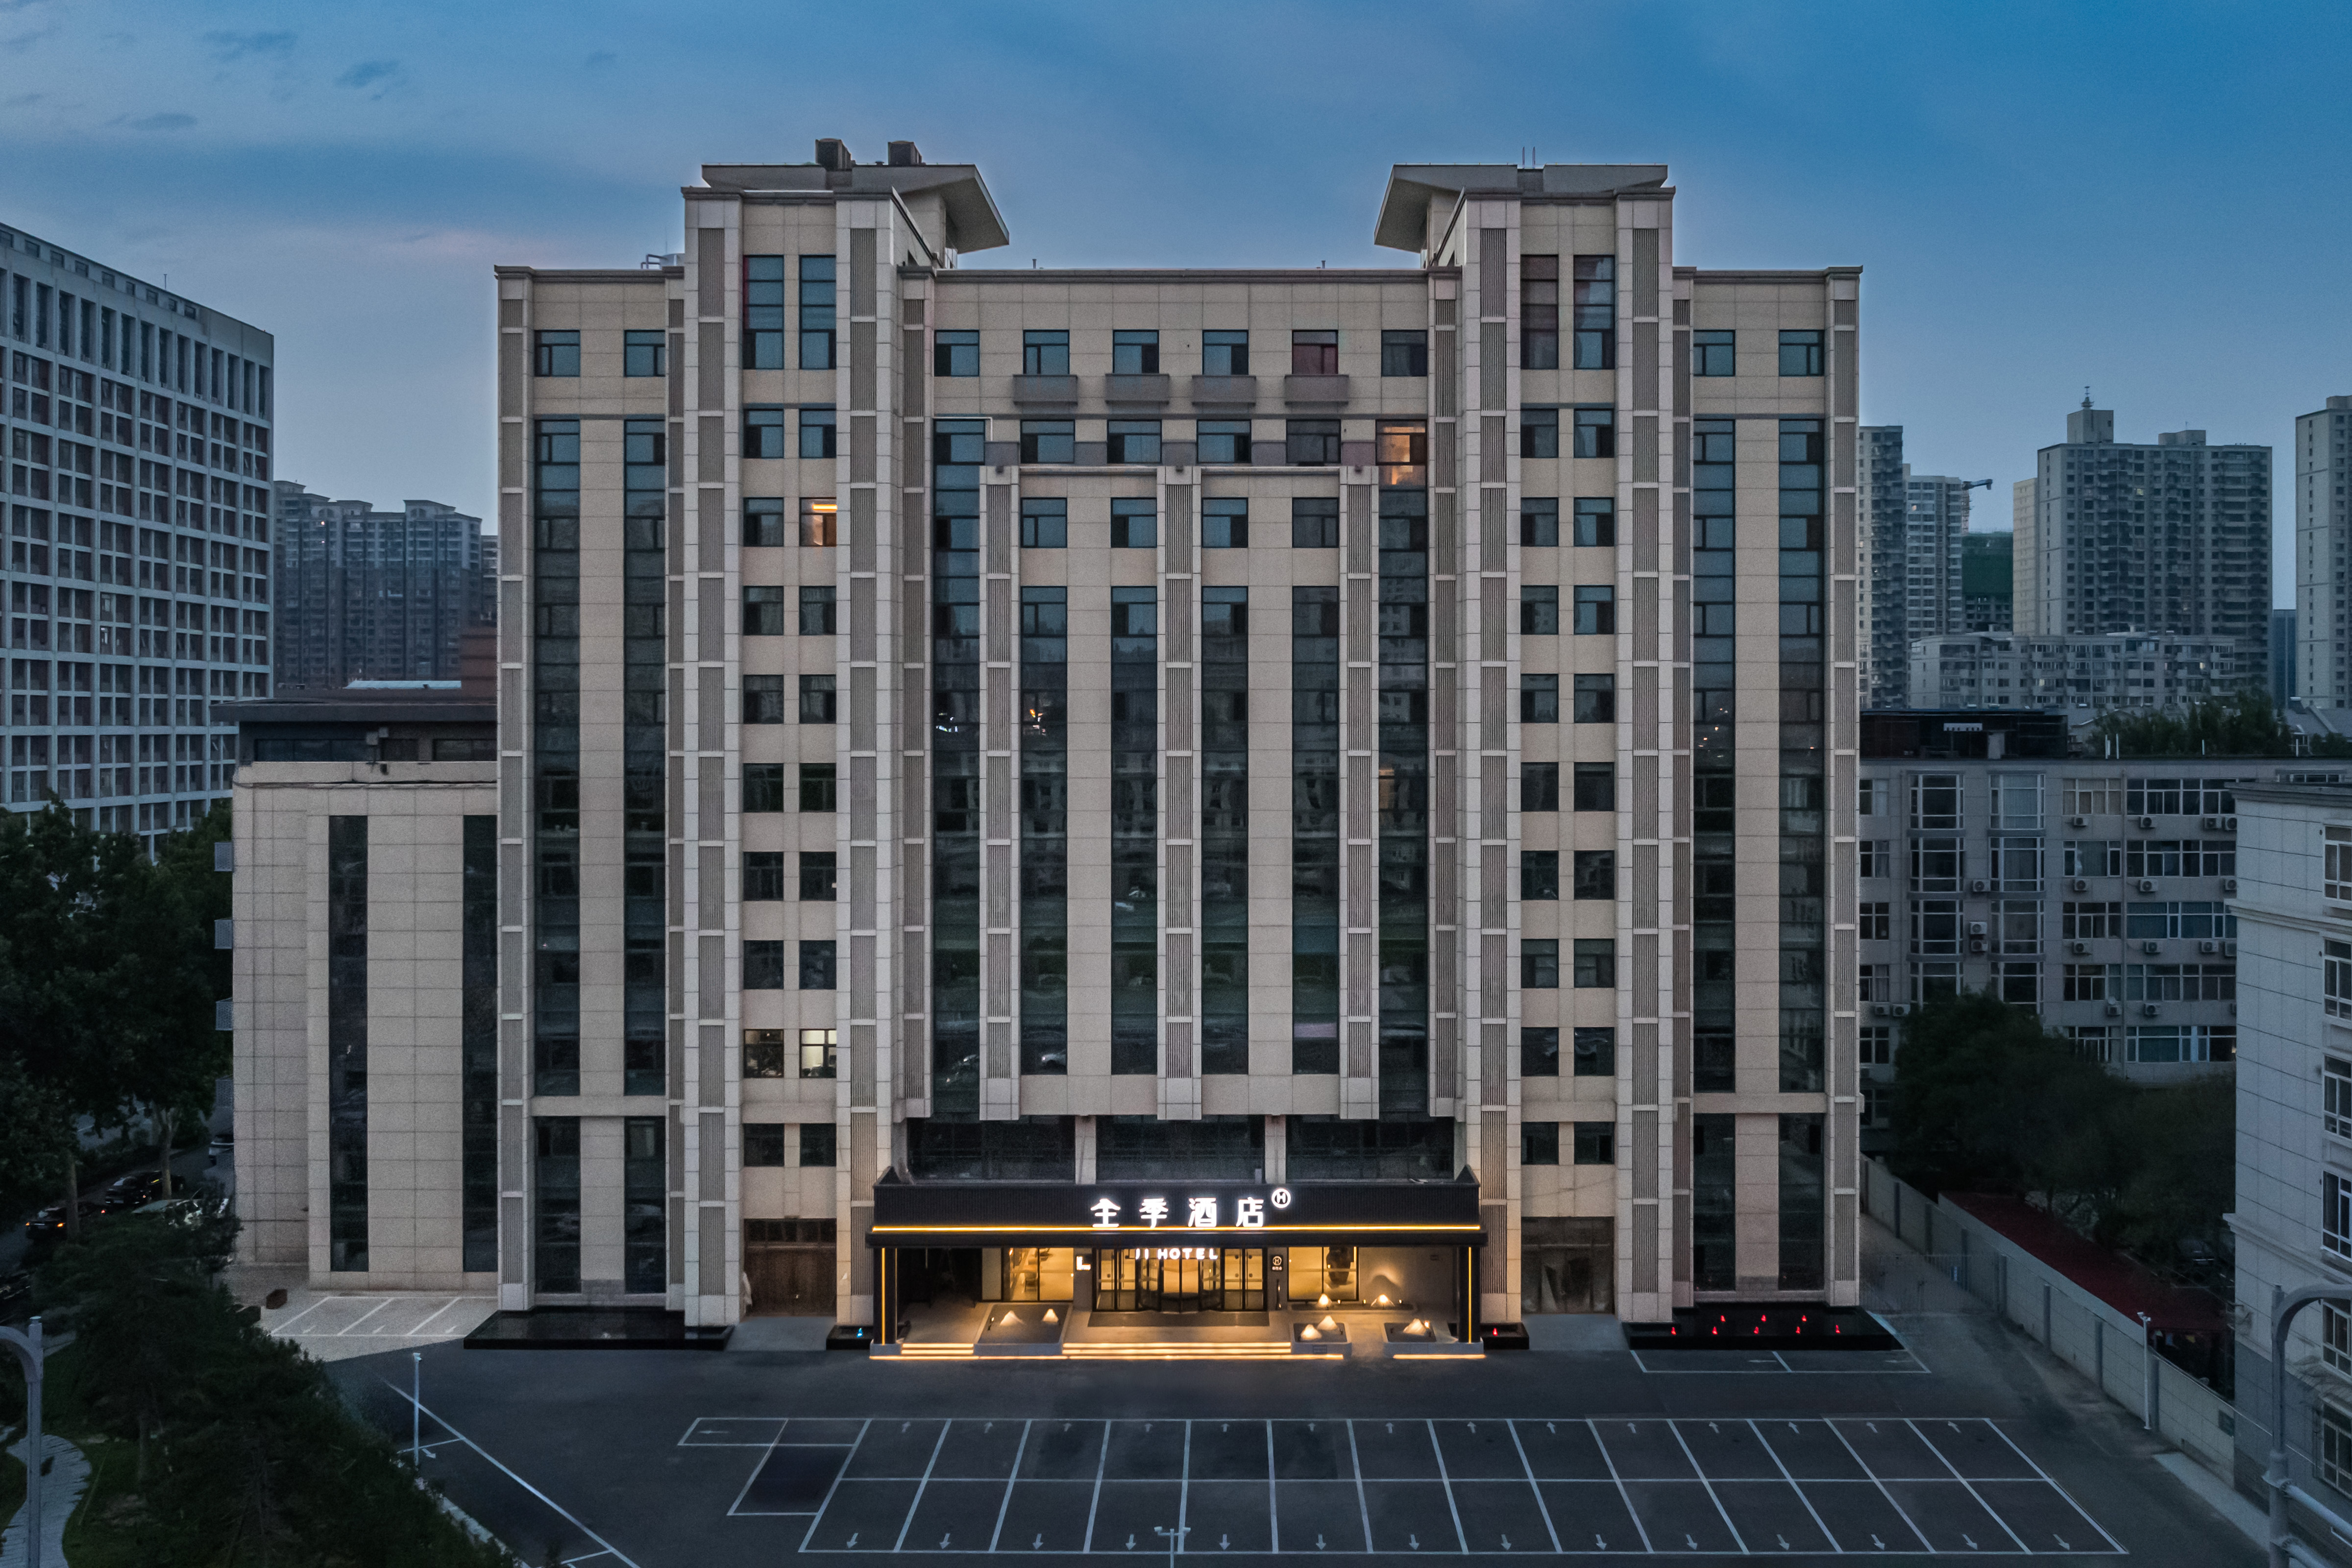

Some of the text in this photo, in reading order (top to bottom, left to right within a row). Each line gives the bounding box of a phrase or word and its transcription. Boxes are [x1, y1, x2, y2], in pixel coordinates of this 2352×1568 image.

[1090, 1196, 1264, 1228] 全季酒店
[1135, 1248, 1218, 1260] JI HOTEL
